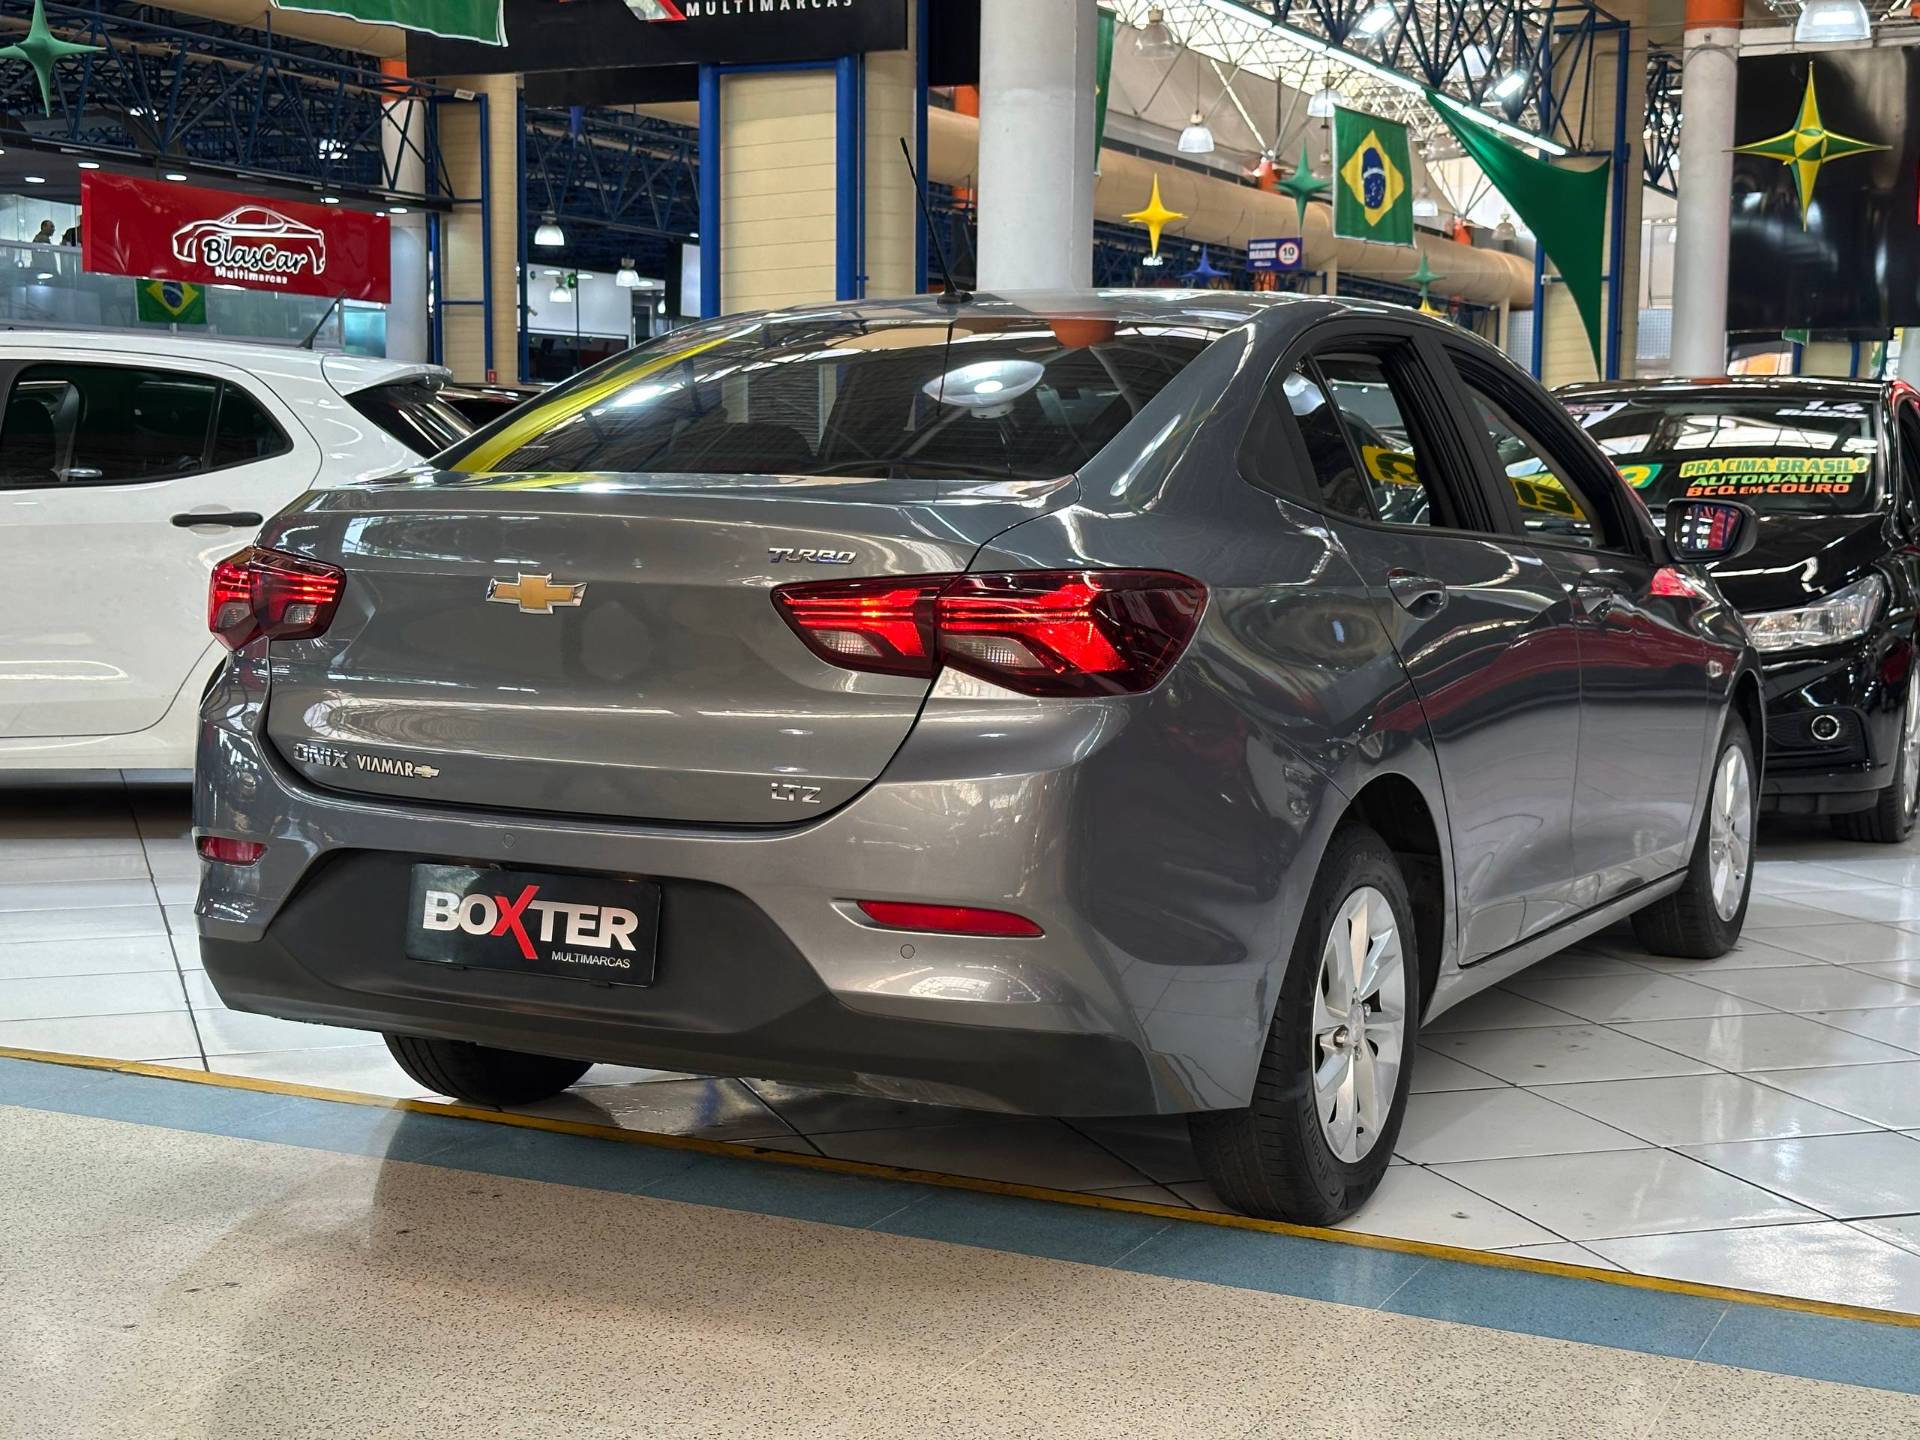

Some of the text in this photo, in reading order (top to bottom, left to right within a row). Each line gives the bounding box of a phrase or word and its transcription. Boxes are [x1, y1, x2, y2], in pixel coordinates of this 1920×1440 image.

[203, 236, 308, 273] BlasCar
[1283, 247, 1295, 256] 10
[215, 266, 288, 284] Multimarcas
[1683, 460, 1721, 476] PRA
[1724, 458, 1770, 474] CIMA
[1740, 486, 1762, 494] EM
[1767, 483, 1850, 493] COURO
[768, 547, 857, 564] TURBO
[293, 743, 414, 777] ONIX VIAMAR
[771, 782, 821, 804] LTZ
[422, 884, 639, 960] BOXTER
[551, 951, 631, 969] MULTIMARCAS
